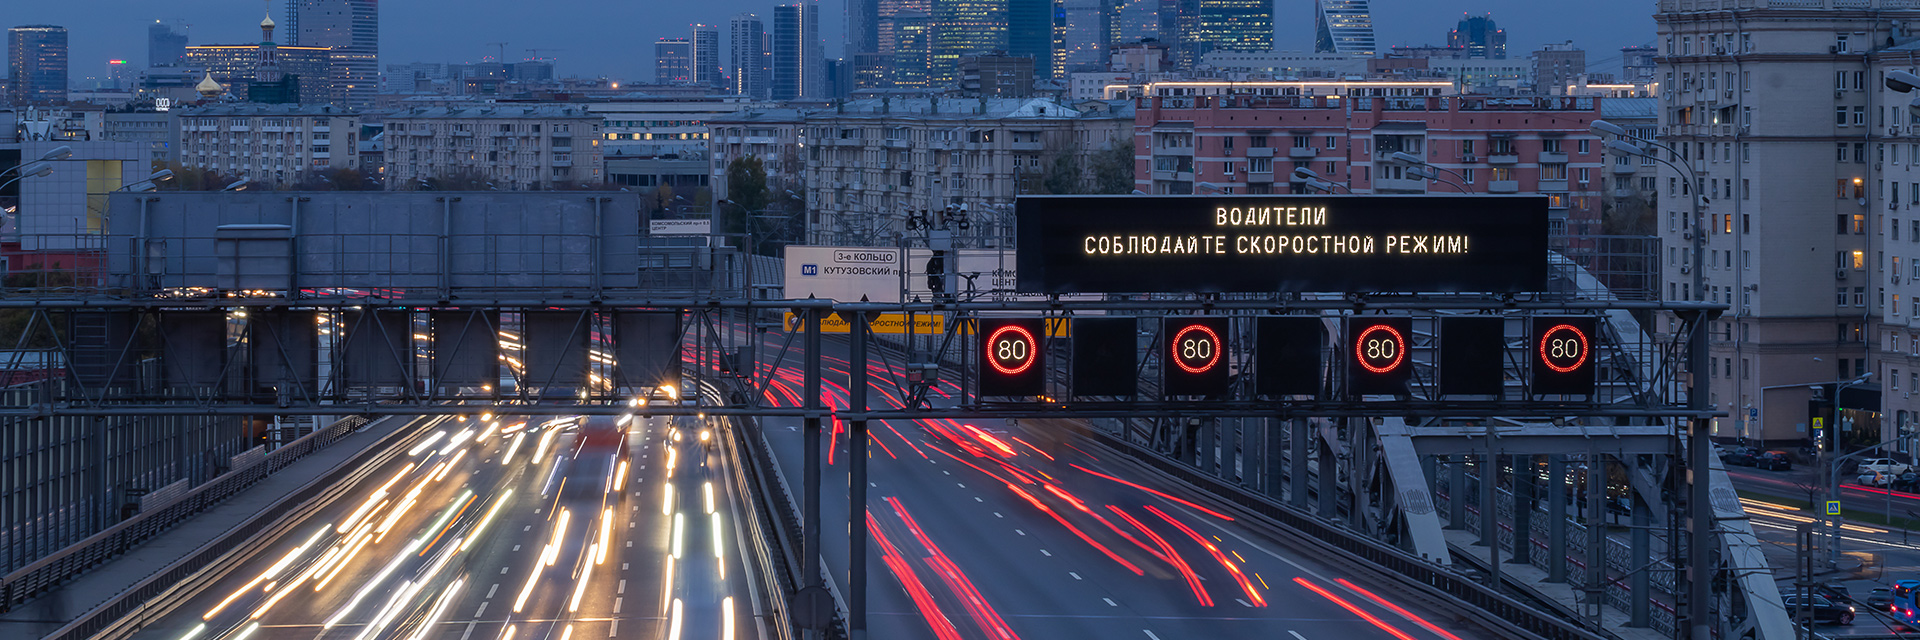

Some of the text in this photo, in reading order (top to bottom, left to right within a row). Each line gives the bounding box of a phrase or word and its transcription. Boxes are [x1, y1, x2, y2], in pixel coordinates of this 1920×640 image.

[1216, 207, 1327, 226] ВОДИТЕЛИ
[1084, 236, 1469, 254] СОБЛЮДАЙТЕ СКОРОСТНОЙ РЕЖИМ!
[838, 253, 893, 263] 3-е КОЛЬЦО
[824, 266, 890, 275] КУТУЗОВСКИЙ
[998, 340, 1026, 360] 80
[1183, 339, 1211, 359] 80
[1367, 338, 1395, 359] 80
[1551, 338, 1578, 359] 80
